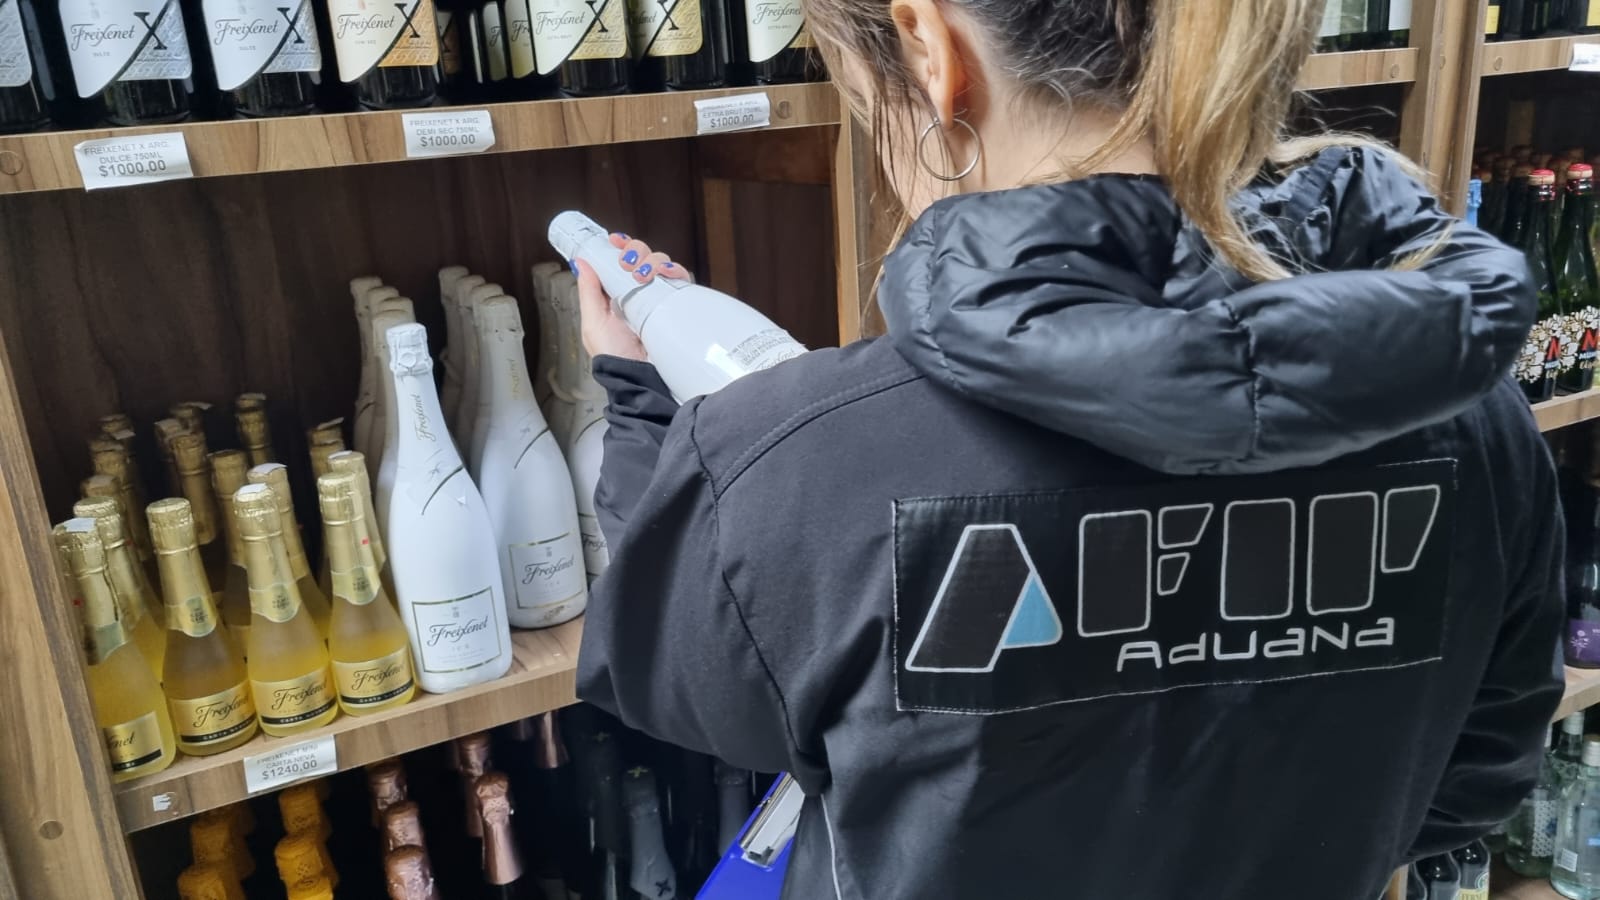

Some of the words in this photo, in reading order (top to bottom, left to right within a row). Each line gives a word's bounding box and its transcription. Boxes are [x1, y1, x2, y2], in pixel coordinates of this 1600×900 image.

[70, 23, 136, 51] Freixenet
[213, 18, 279, 45] Freixenet
[336, 13, 396, 39] Freixenet
[420, 133, 476, 148] $1000.00
[98, 155, 132, 166] DULCE
[134, 151, 163, 161] 750ML
[98, 159, 167, 178] $1000.00
[426, 615, 489, 648] Freixenet
[262, 759, 318, 780] $1240.00
